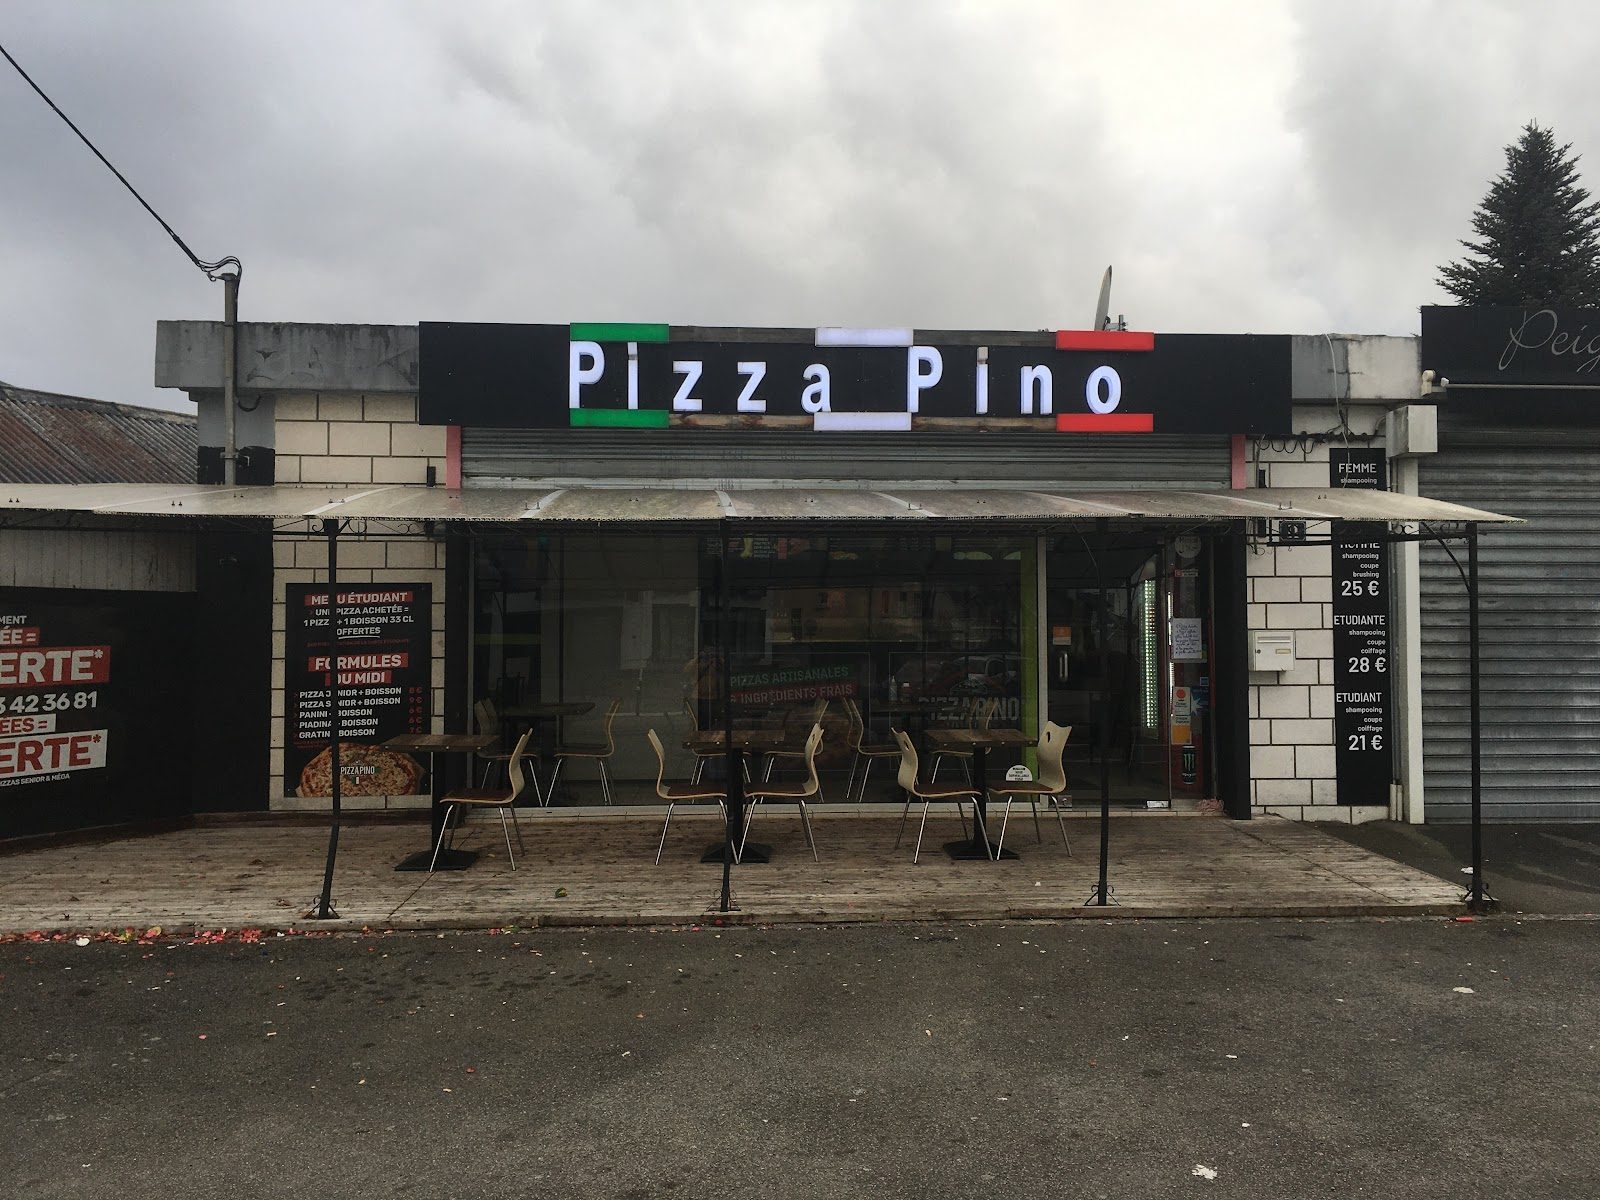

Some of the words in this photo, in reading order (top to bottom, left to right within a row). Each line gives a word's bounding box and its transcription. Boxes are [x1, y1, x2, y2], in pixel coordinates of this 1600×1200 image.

[569, 340, 831, 413] Pizza
[907, 345, 1122, 415] Pino
[1338, 463, 1377, 473] FEMME
[1340, 477, 1378, 485] shampooing
[1341, 580, 1363, 596] 25
[1367, 580, 1380, 596] €
[311, 595, 346, 605] MEU
[347, 592, 408, 604] ÉTUDIANT
[315, 608, 330, 616] UN
[336, 607, 361, 615] PIZZA
[362, 604, 403, 614] ACHETÉE
[309, 619, 329, 627] PIZZ
[350, 616, 388, 625] BOISSON
[402, 615, 414, 623] CL
[1334, 615, 1386, 625] ETUDIANTE
[336, 627, 381, 636] OFFERTES
[1349, 629, 1386, 637] shampooing
[1361, 647, 1386, 655] coiffage
[1348, 657, 1370, 673] 28
[1374, 657, 1387, 673] €
[355, 672, 385, 684] MIDI
[772, 666, 849, 683] ARTISANALES
[300, 690, 324, 698] PIZZA
[325, 689, 357, 698] JNIOR
[365, 687, 402, 696] BOISSON
[820, 684, 853, 697] FRAIS
[9, 694, 39, 713] 42
[42, 692, 70, 711] 36
[73, 691, 97, 709] 81
[300, 700, 324, 708] PIZZA
[325, 699, 356, 708] SNIOR
[364, 697, 401, 706] BOISSON
[1336, 693, 1382, 703] ETUDIANT
[299, 710, 328, 719] PANINI
[341, 718, 378, 727] BOISSON
[299, 730, 331, 739] GRATIN
[338, 728, 375, 737] BOISSON
[1348, 735, 1366, 750] 21
[1371, 735, 1383, 750] €
